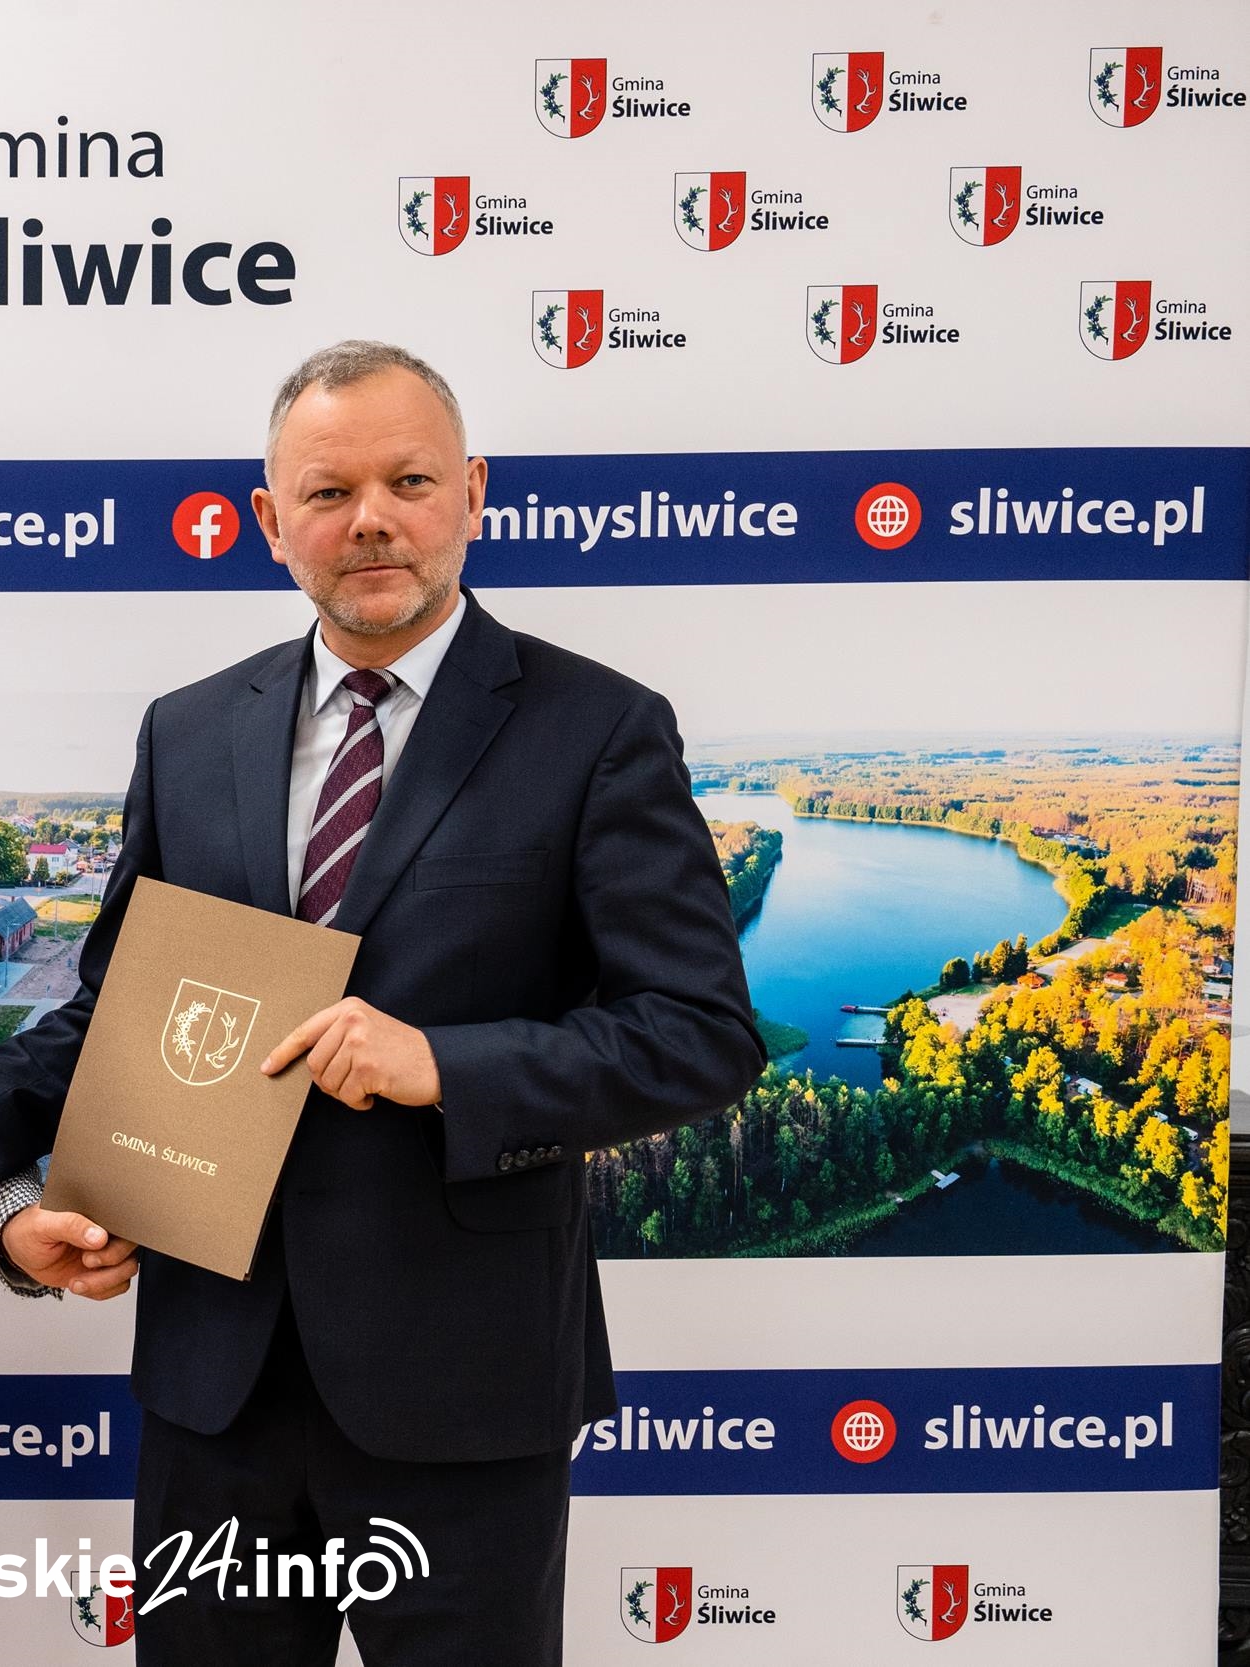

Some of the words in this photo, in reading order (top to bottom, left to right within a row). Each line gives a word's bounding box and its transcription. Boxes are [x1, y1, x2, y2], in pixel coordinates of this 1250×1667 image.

[613, 77, 663, 91] Gmina
[889, 71, 940, 85] Gmina
[1168, 66, 1219, 80] Gmina
[613, 95, 690, 117] Śliwice
[889, 89, 967, 111] Śliwice
[1167, 84, 1246, 107] Śliwice
[476, 195, 526, 209] Gmina
[752, 190, 802, 204] Gmina
[1027, 185, 1077, 199] Gmina
[476, 213, 553, 235] Śliwice
[751, 208, 828, 230] Śliwice
[1026, 203, 1103, 225] Śliwice
[609, 308, 659, 322] Gmina
[883, 304, 933, 317] Gmina
[1156, 300, 1206, 313] Gmina
[609, 327, 686, 348] Śliwice
[883, 322, 959, 344] Śliwice
[1155, 318, 1231, 340] Śliwice
[475, 492, 797, 552] minysliwice
[950, 487, 1204, 545] sliwice.pl
[112, 1133, 155, 1157] GMINA
[162, 1147, 217, 1176] ŚLIWICE
[925, 1402, 1172, 1458] sliwice.pl
[698, 1585, 748, 1598] Gmina
[974, 1583, 1025, 1596] Gmina
[698, 1602, 775, 1624] Śliwice
[974, 1600, 1052, 1622] Śliwice
